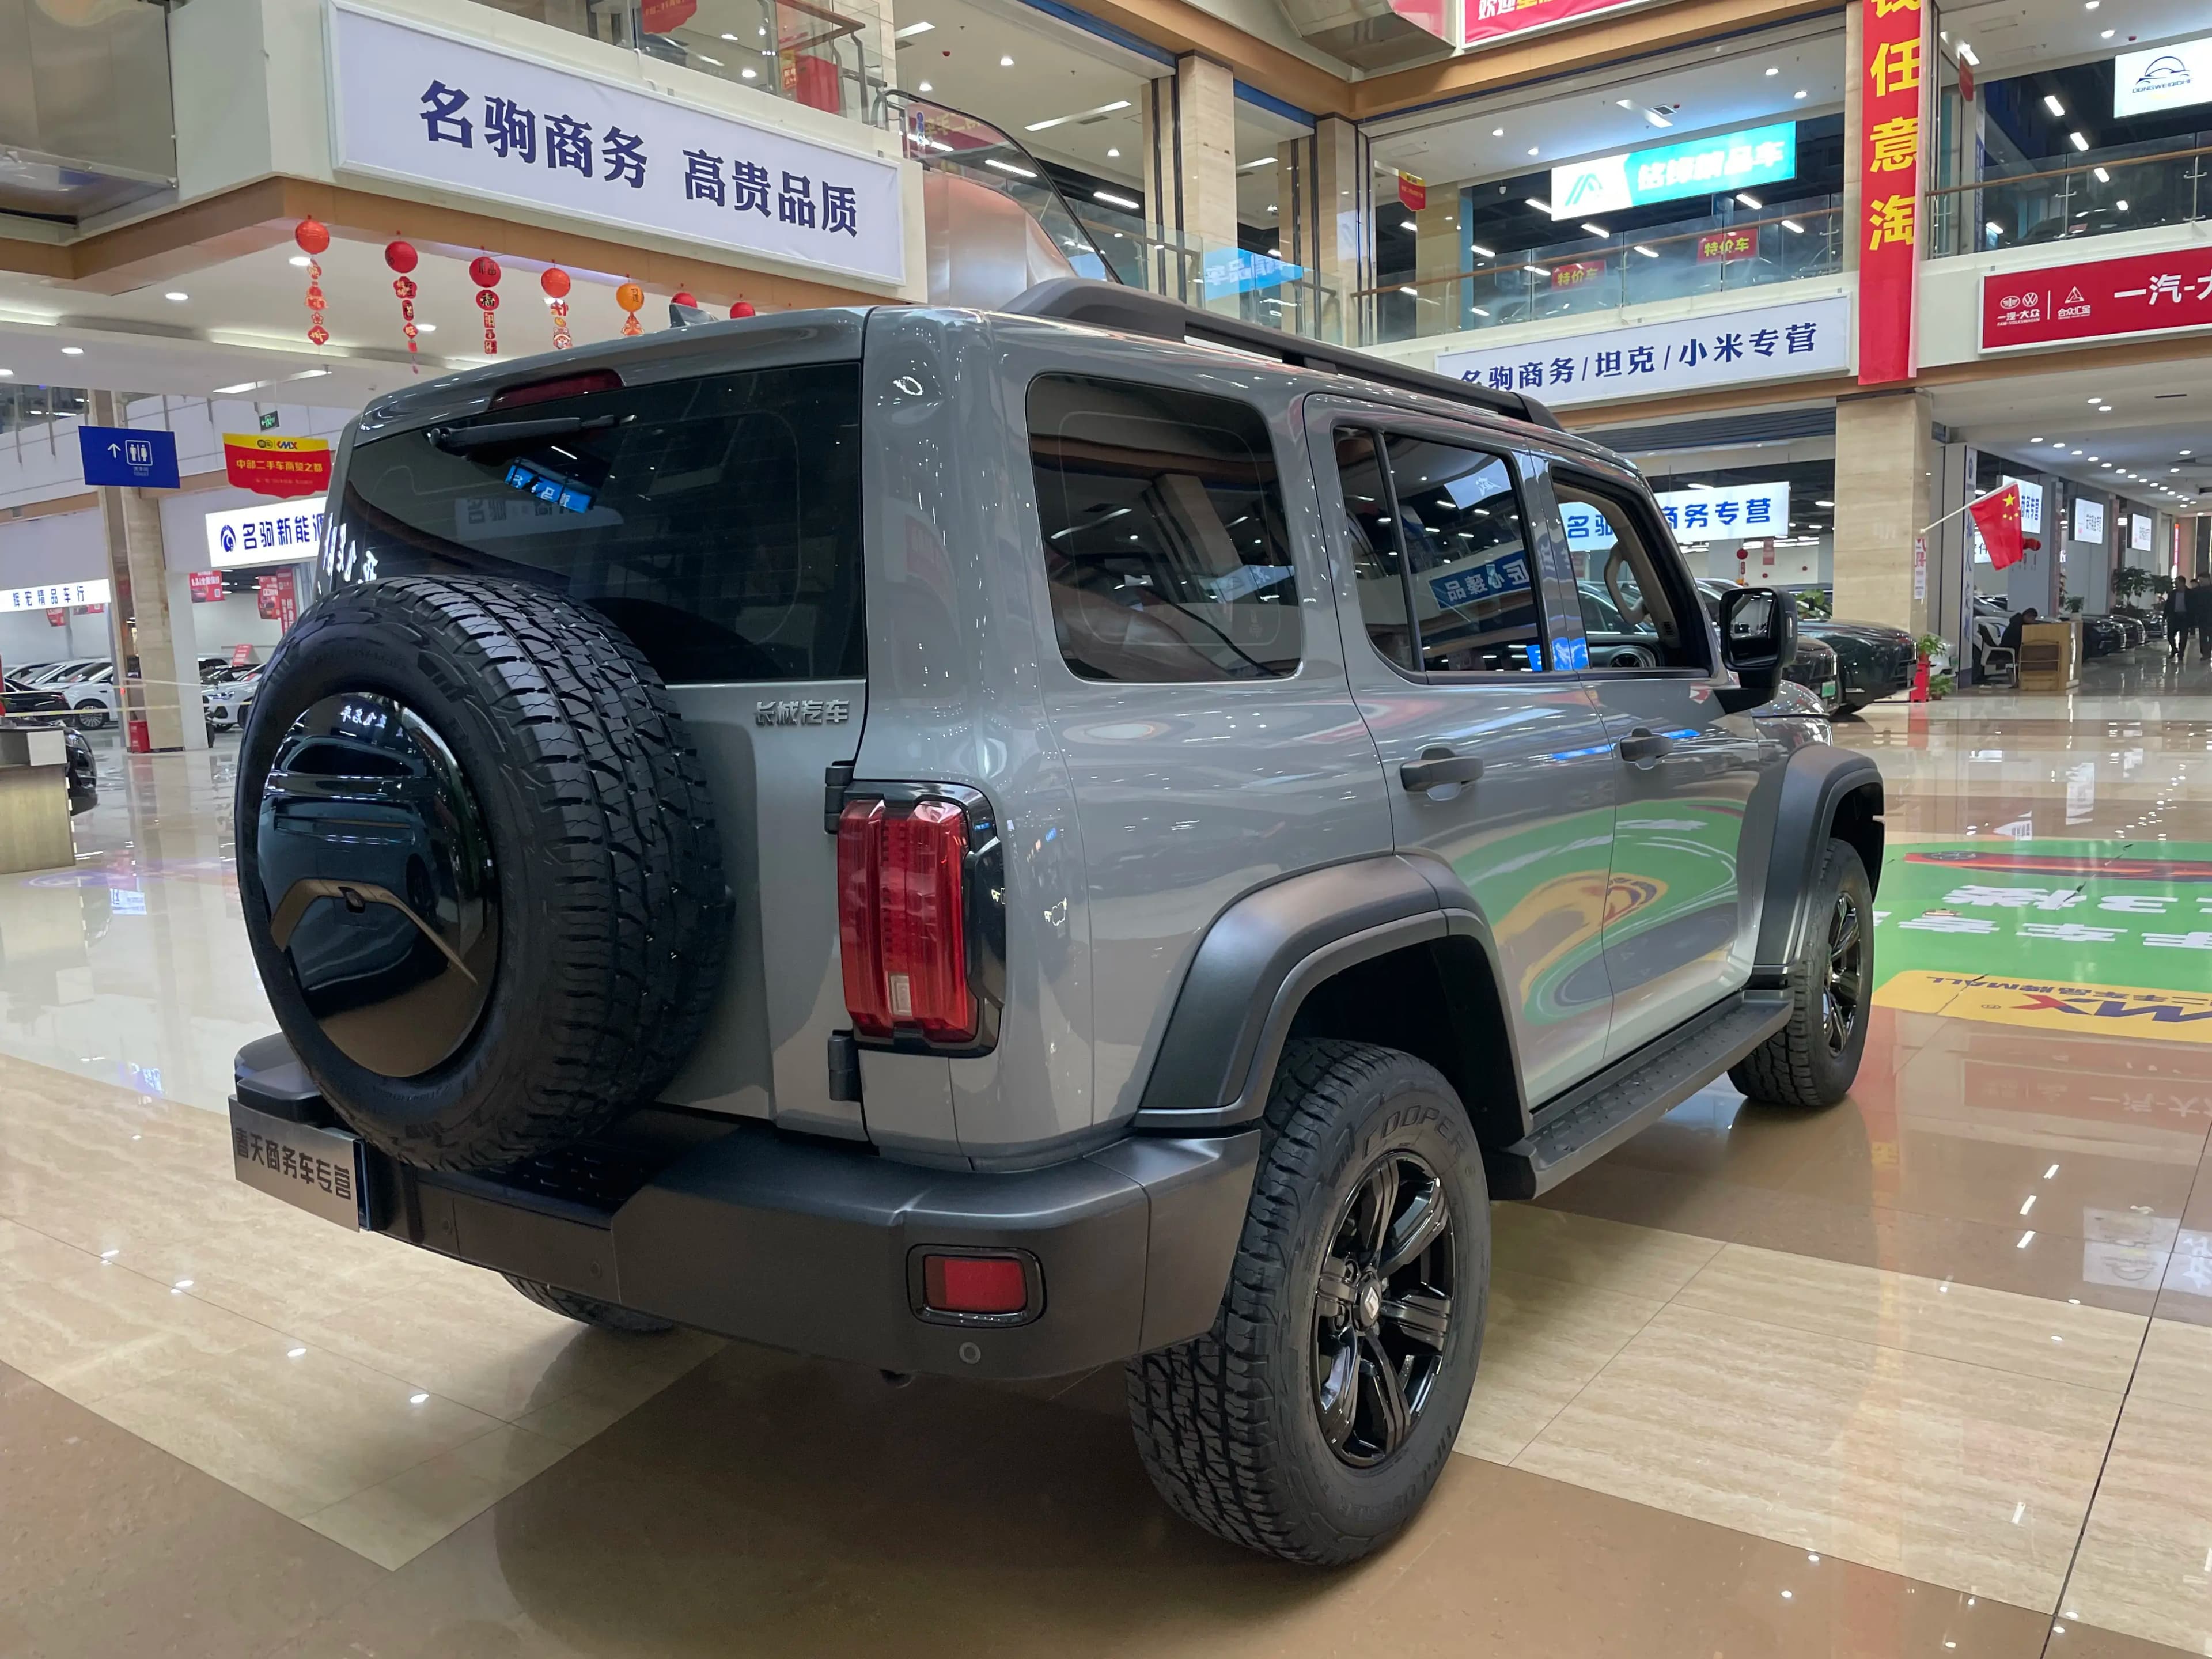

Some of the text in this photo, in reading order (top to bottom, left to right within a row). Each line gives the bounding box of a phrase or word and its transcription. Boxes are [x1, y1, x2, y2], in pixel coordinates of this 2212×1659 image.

[420, 79, 858, 238] 名驹商务 高贵品质
[1702, 236, 1749, 257] 特价车
[1556, 266, 1598, 286] 特价车
[236, 460, 323, 472] 中部二手车商贸之都
[755, 699, 850, 726] 长城汽车
[1942, 884, 2212, 913] 3楼
[1362, 1104, 1469, 1160] COOPER
[235, 1127, 351, 1200] 春天商务车专营
